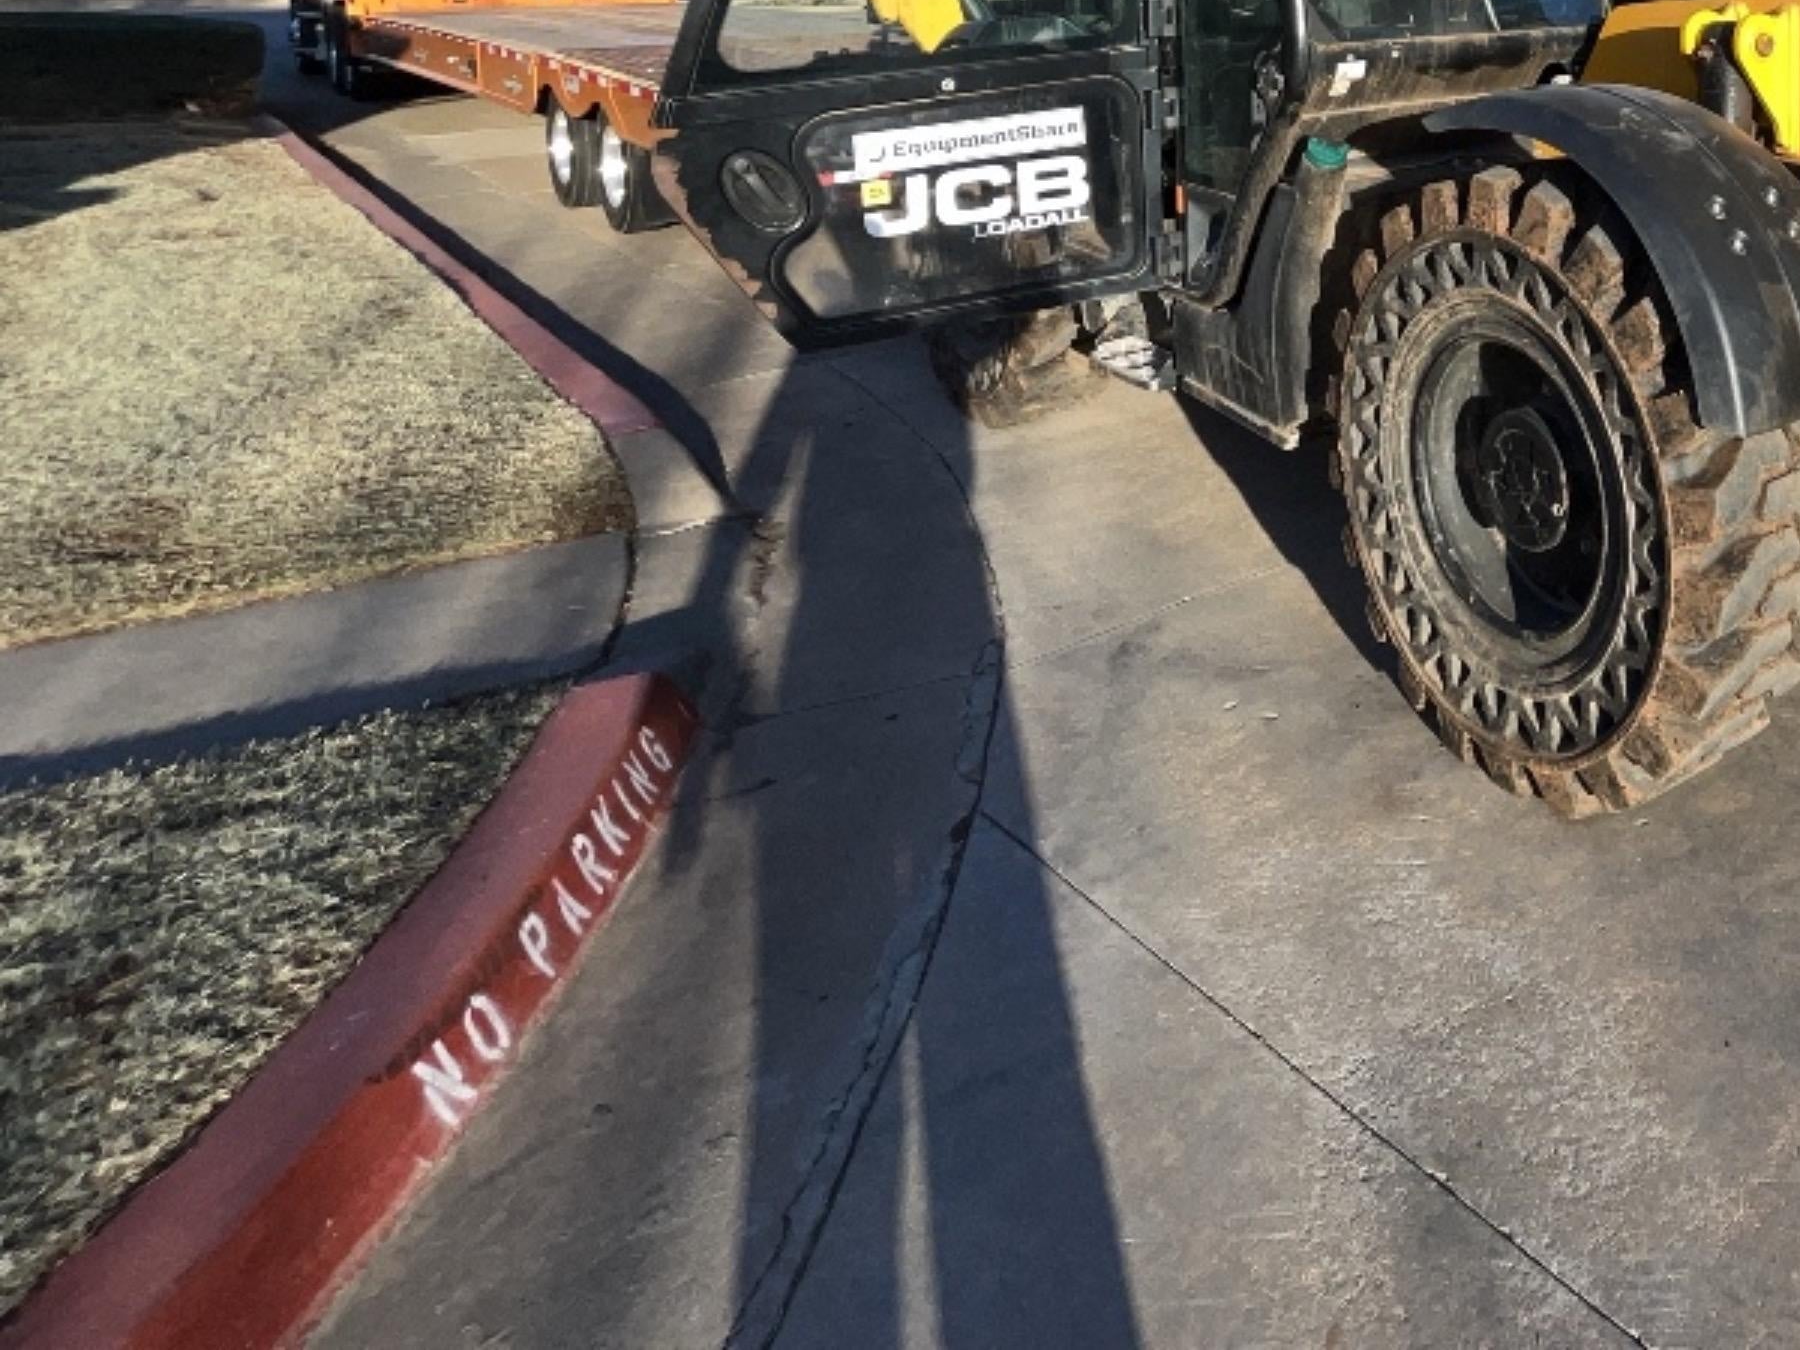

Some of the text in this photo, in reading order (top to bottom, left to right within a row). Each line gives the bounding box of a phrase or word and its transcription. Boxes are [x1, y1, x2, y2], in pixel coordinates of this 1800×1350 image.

[864, 155, 1090, 238] JCB
[974, 207, 1090, 238] LOADALL
[412, 725, 673, 1128] NO PARKING
